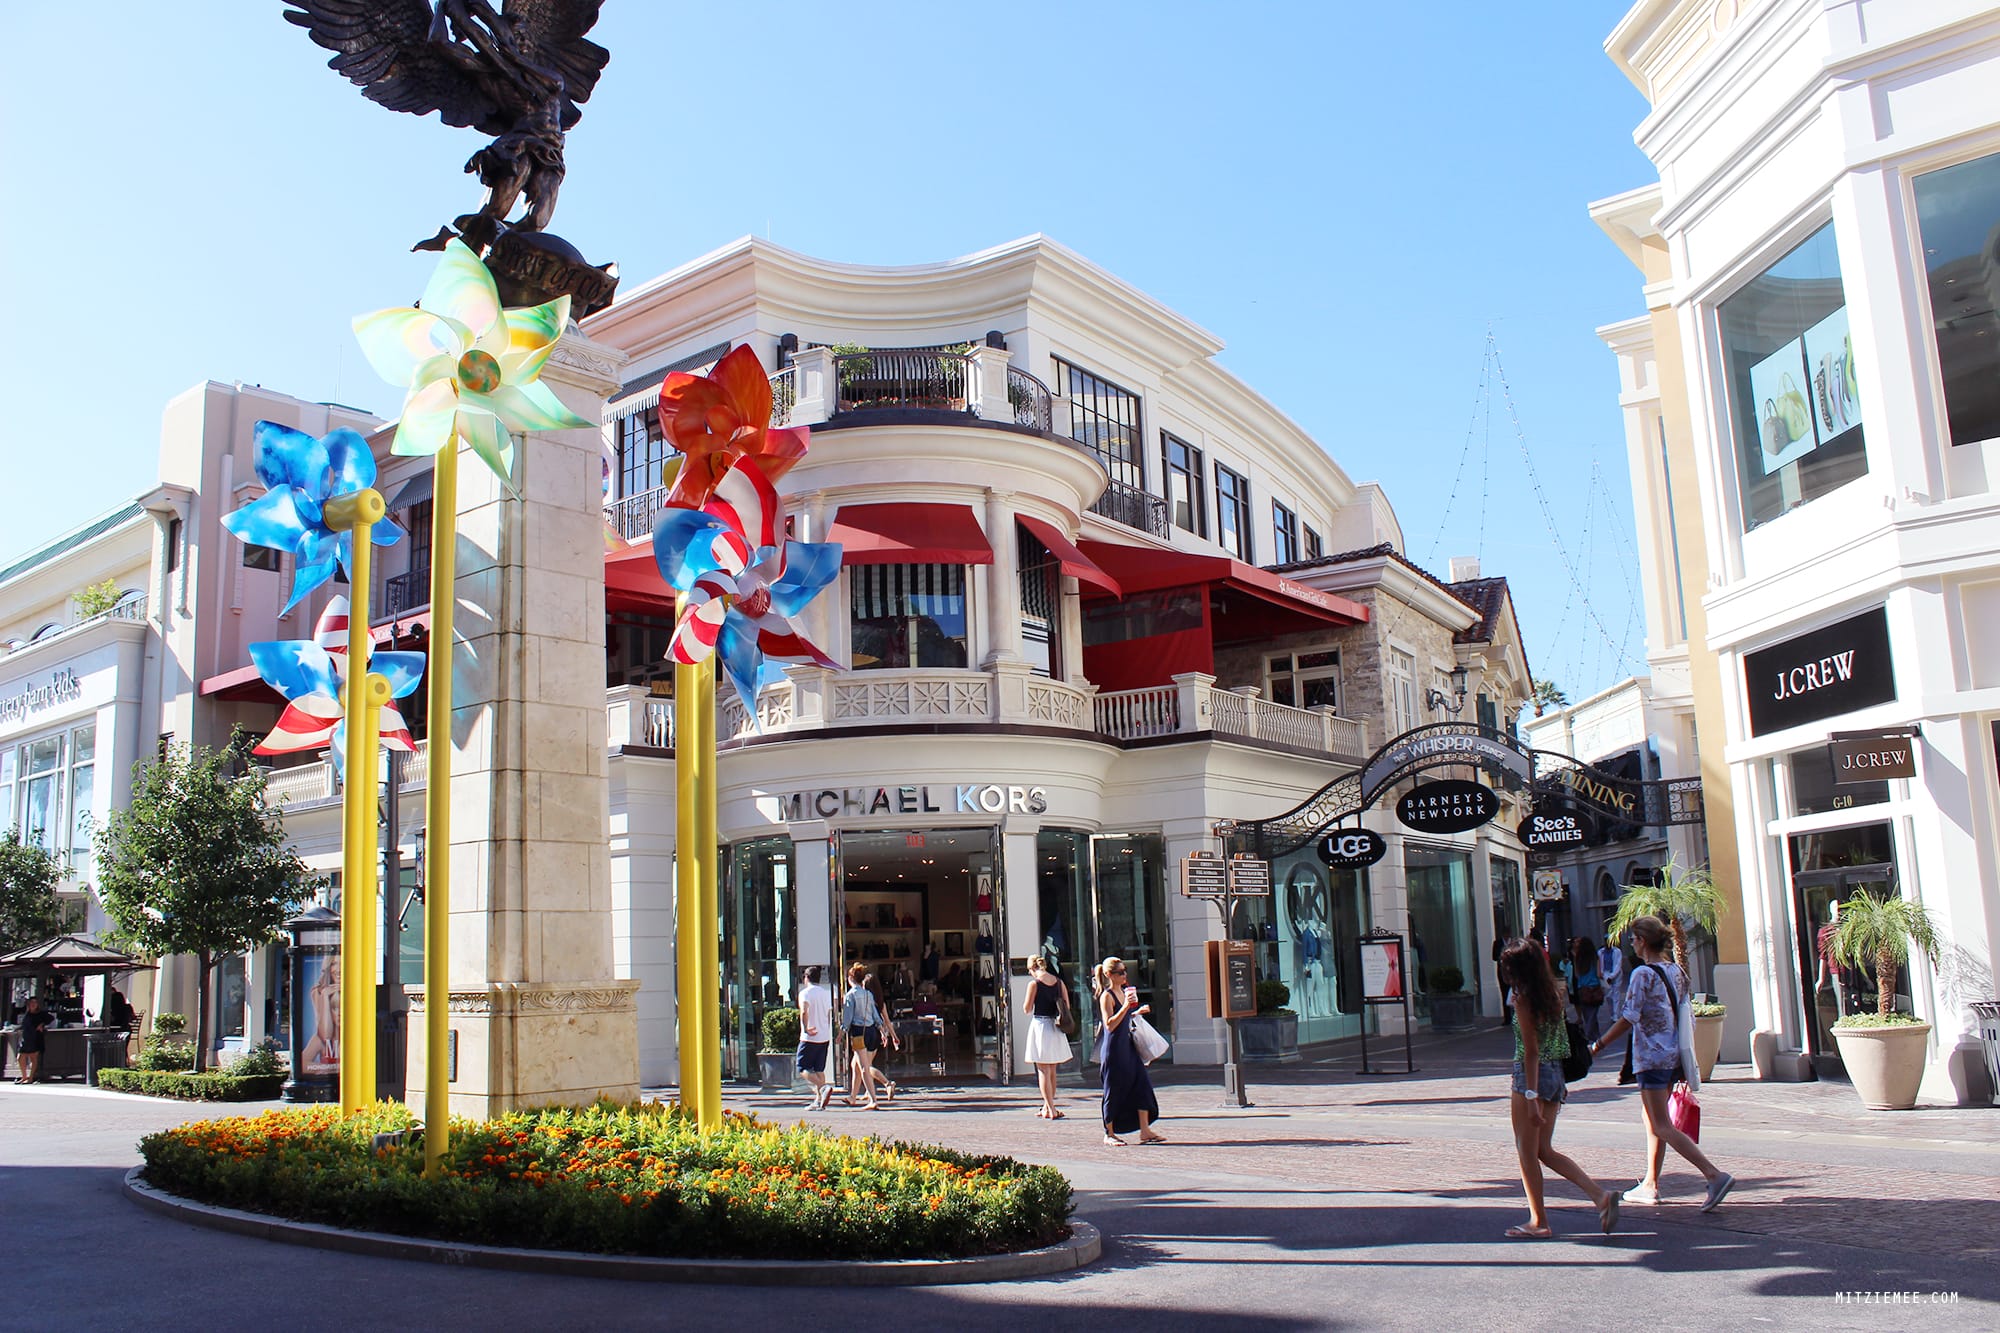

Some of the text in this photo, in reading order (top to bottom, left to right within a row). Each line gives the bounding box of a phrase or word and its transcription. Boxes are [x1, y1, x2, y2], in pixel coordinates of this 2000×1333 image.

[1774, 649, 1856, 700] J.CREW
[25, 682, 49, 707] barn
[52, 667, 78, 697] kids
[1408, 737, 1473, 757] WHISPER
[1476, 743, 1506, 761] LOUNGE
[1842, 750, 1907, 769] J.CREW
[1407, 792, 1484, 809] BARNEYS
[1559, 768, 1636, 811] DINING
[1833, 794, 1853, 809] G-10
[778, 784, 1047, 821] MICHAEL KORS
[1533, 816, 1576, 832] See's
[1327, 834, 1372, 858] UGG
[1528, 829, 1583, 845] CANDIES
